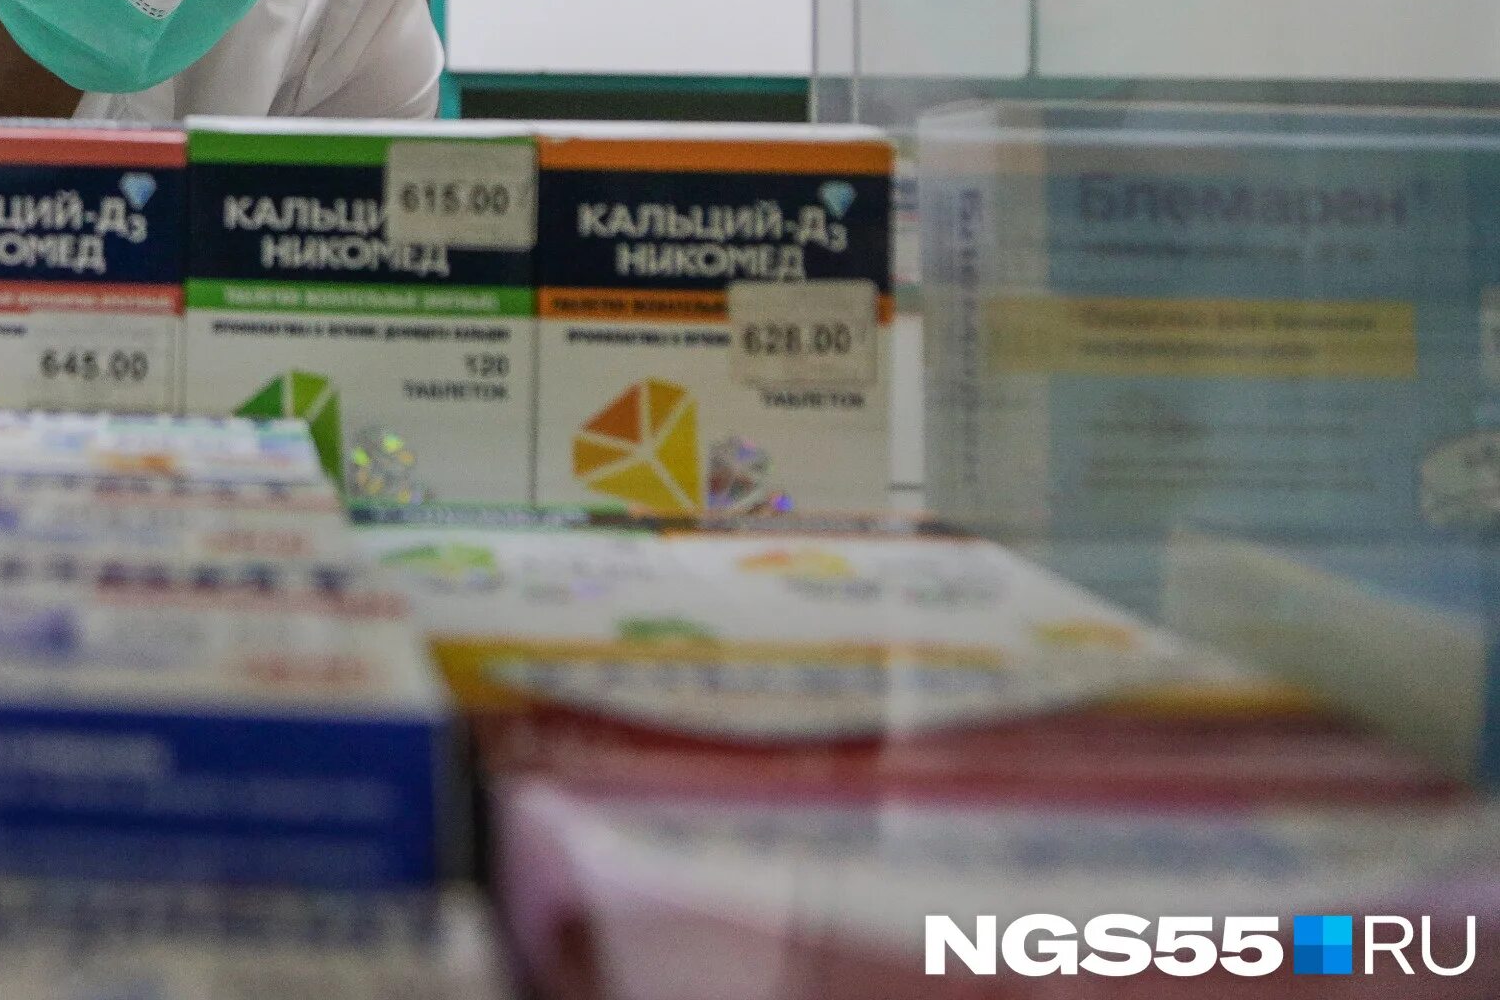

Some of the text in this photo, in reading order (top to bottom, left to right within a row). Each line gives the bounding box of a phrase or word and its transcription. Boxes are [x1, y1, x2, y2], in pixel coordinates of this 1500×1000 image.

[402, 181, 510, 216] 615.00
[260, 234, 449, 278] НИКОМЕД
[616, 242, 806, 282] НИКОМЕД
[39, 349, 149, 382] 645.00
